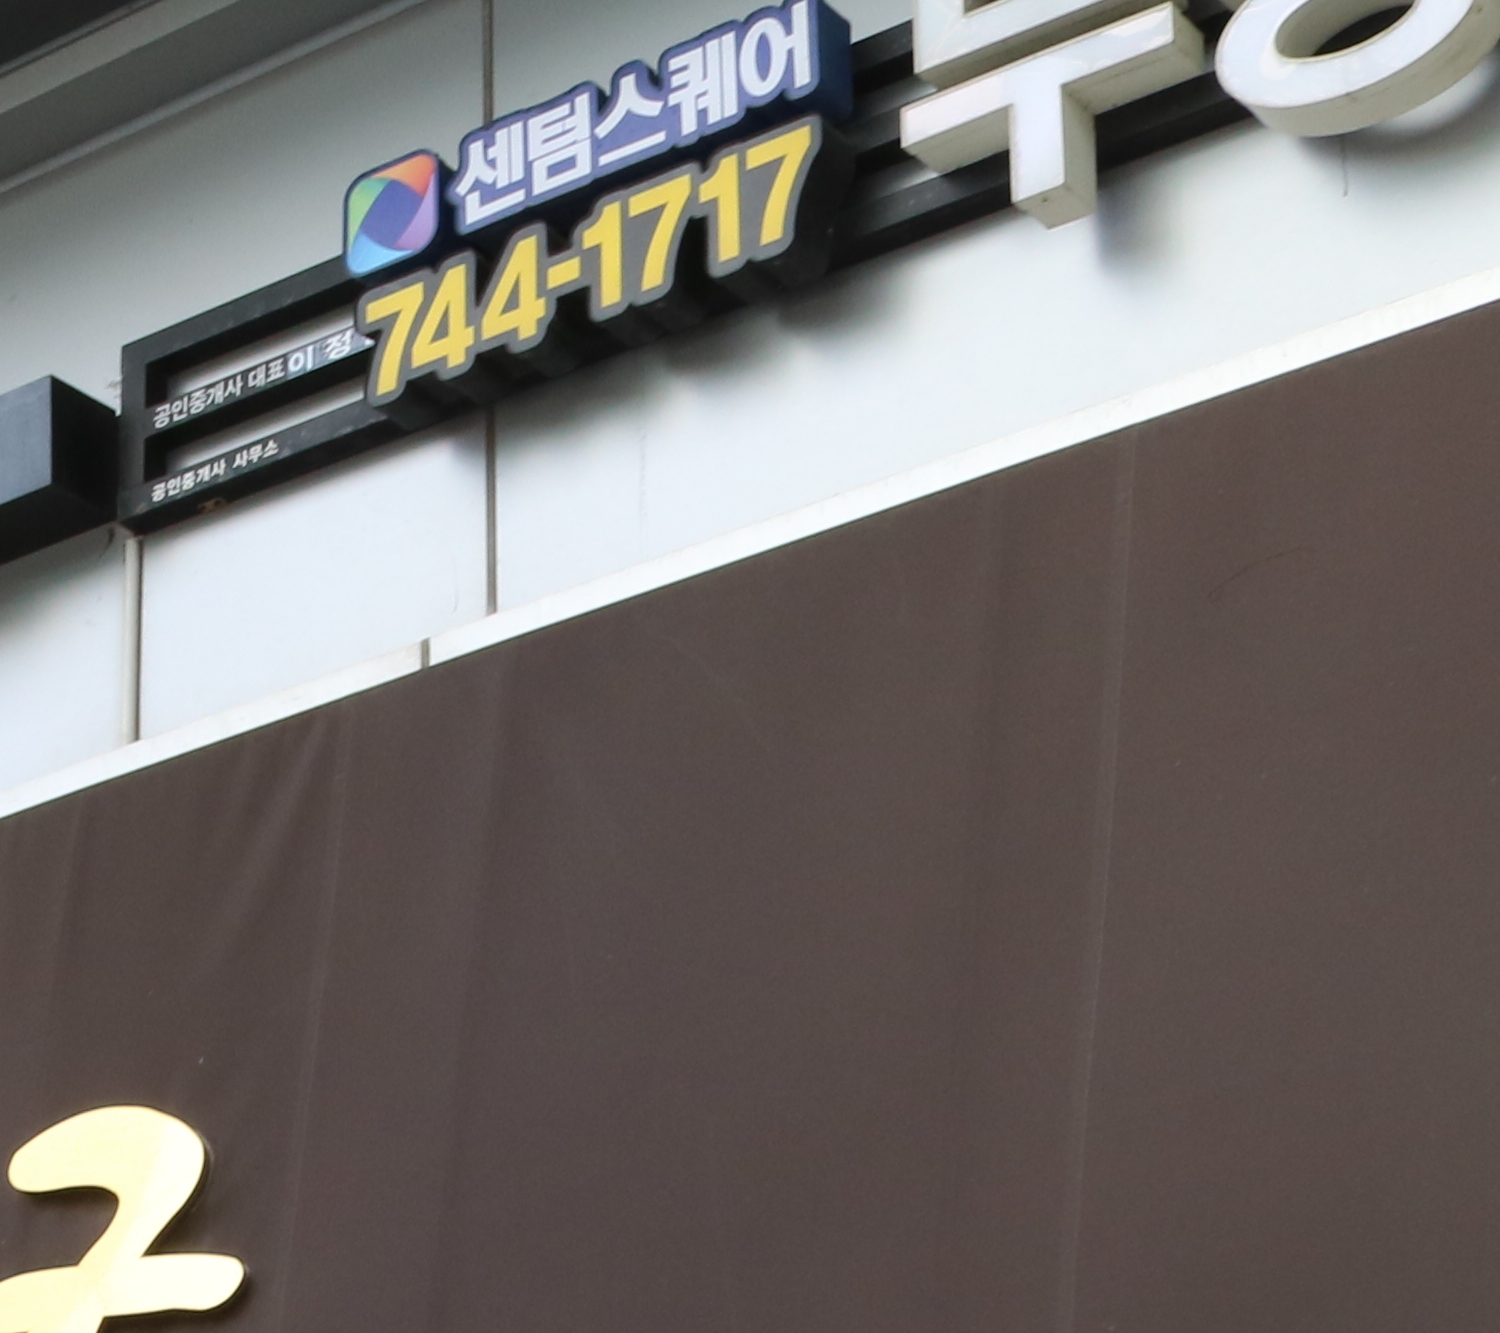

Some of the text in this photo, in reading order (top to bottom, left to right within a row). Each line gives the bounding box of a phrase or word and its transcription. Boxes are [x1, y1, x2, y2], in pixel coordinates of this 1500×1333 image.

[455, 2, 812, 226] 센텀스퀘어
[365, 124, 812, 397] 744-1717
[152, 374, 243, 430] 공인중개사
[247, 361, 286, 389] 대표
[287, 346, 314, 373] 이
[151, 439, 279, 502] 공인중개사 사무소
